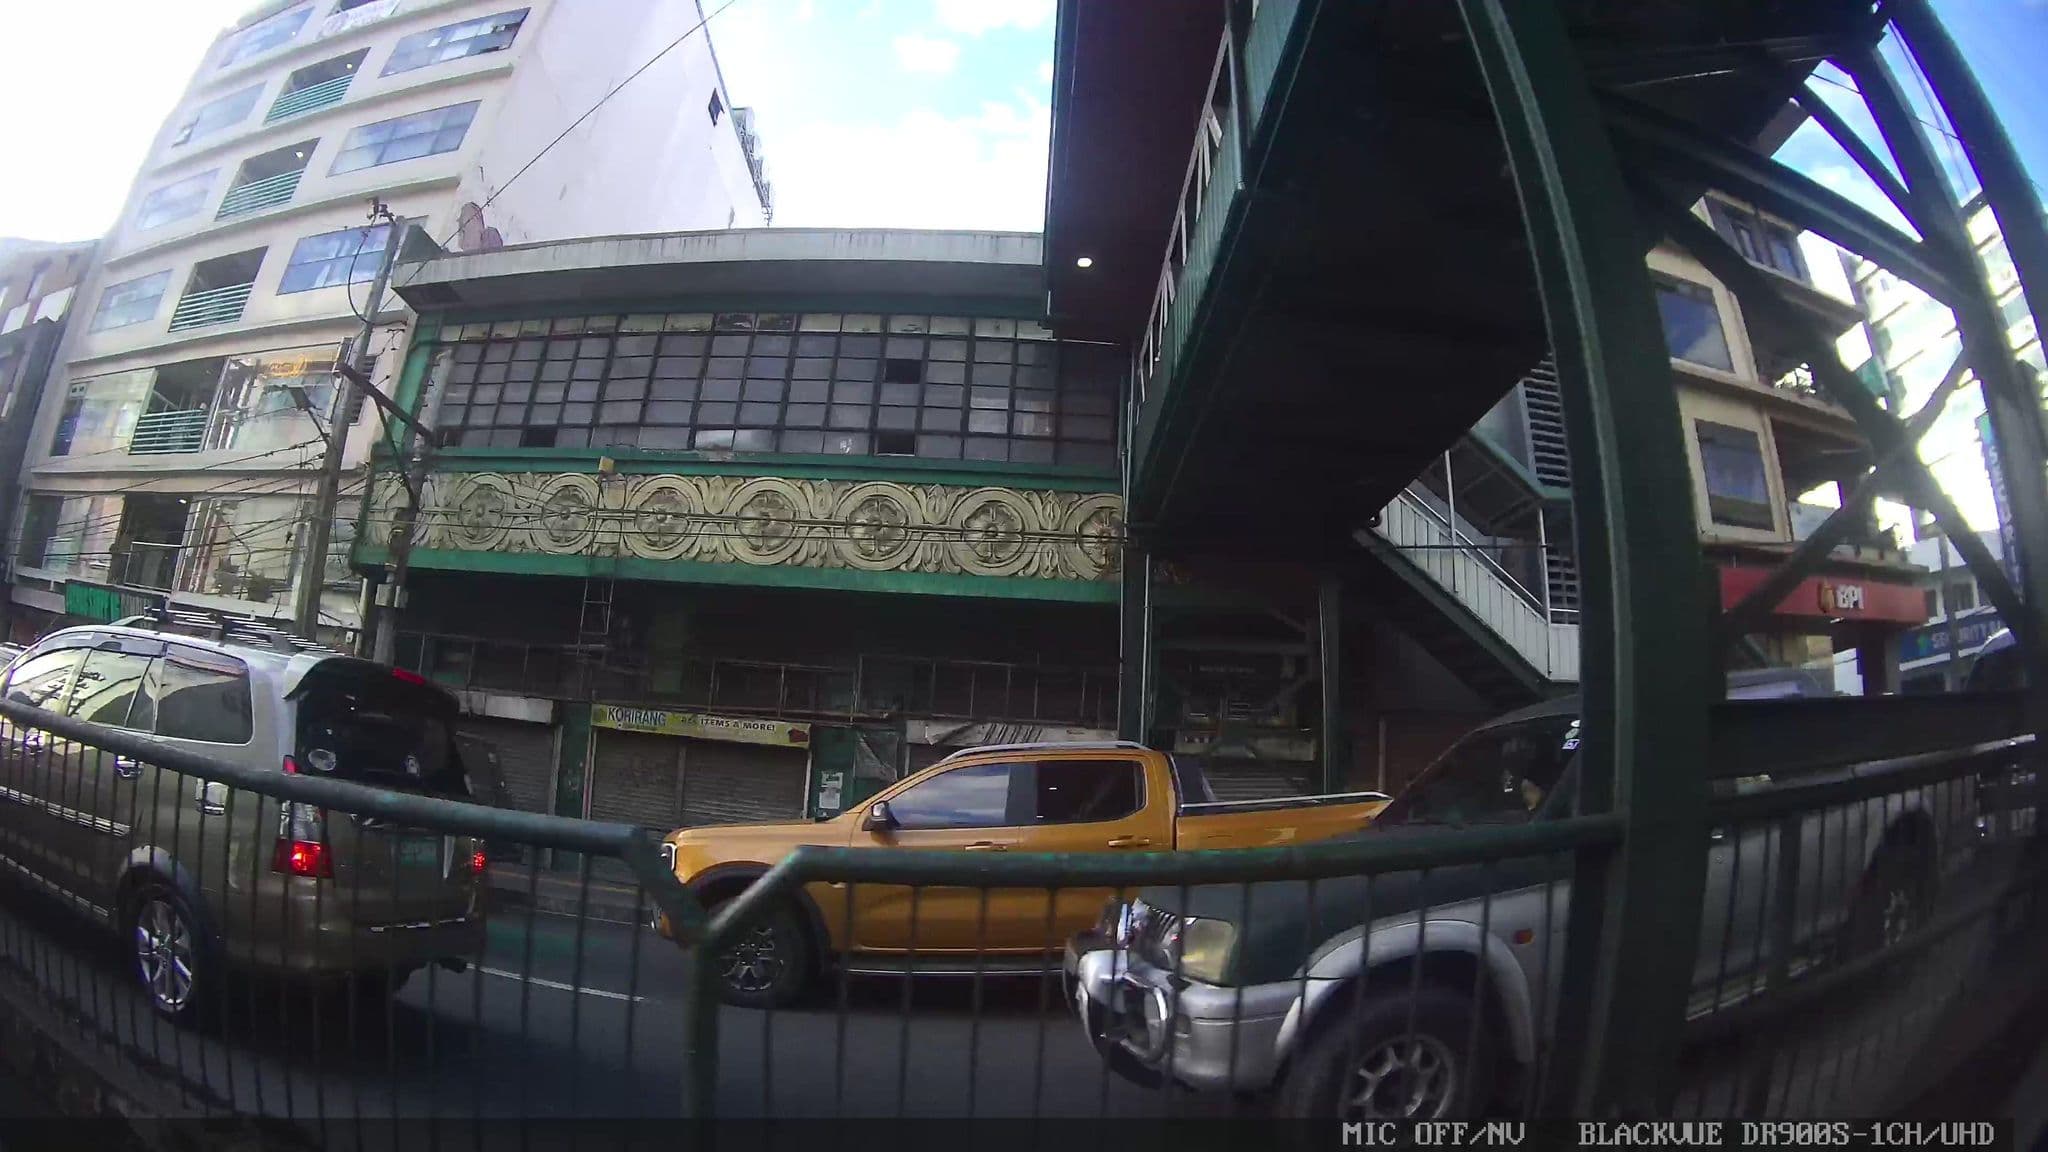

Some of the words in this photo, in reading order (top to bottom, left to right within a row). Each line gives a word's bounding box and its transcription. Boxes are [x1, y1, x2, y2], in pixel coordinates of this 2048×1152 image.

[1836, 585, 1864, 609] BPI
[607, 706, 667, 727] KORIRANG
[700, 718, 730, 728] ITEMS
[742, 721, 776, 731] MORE!
